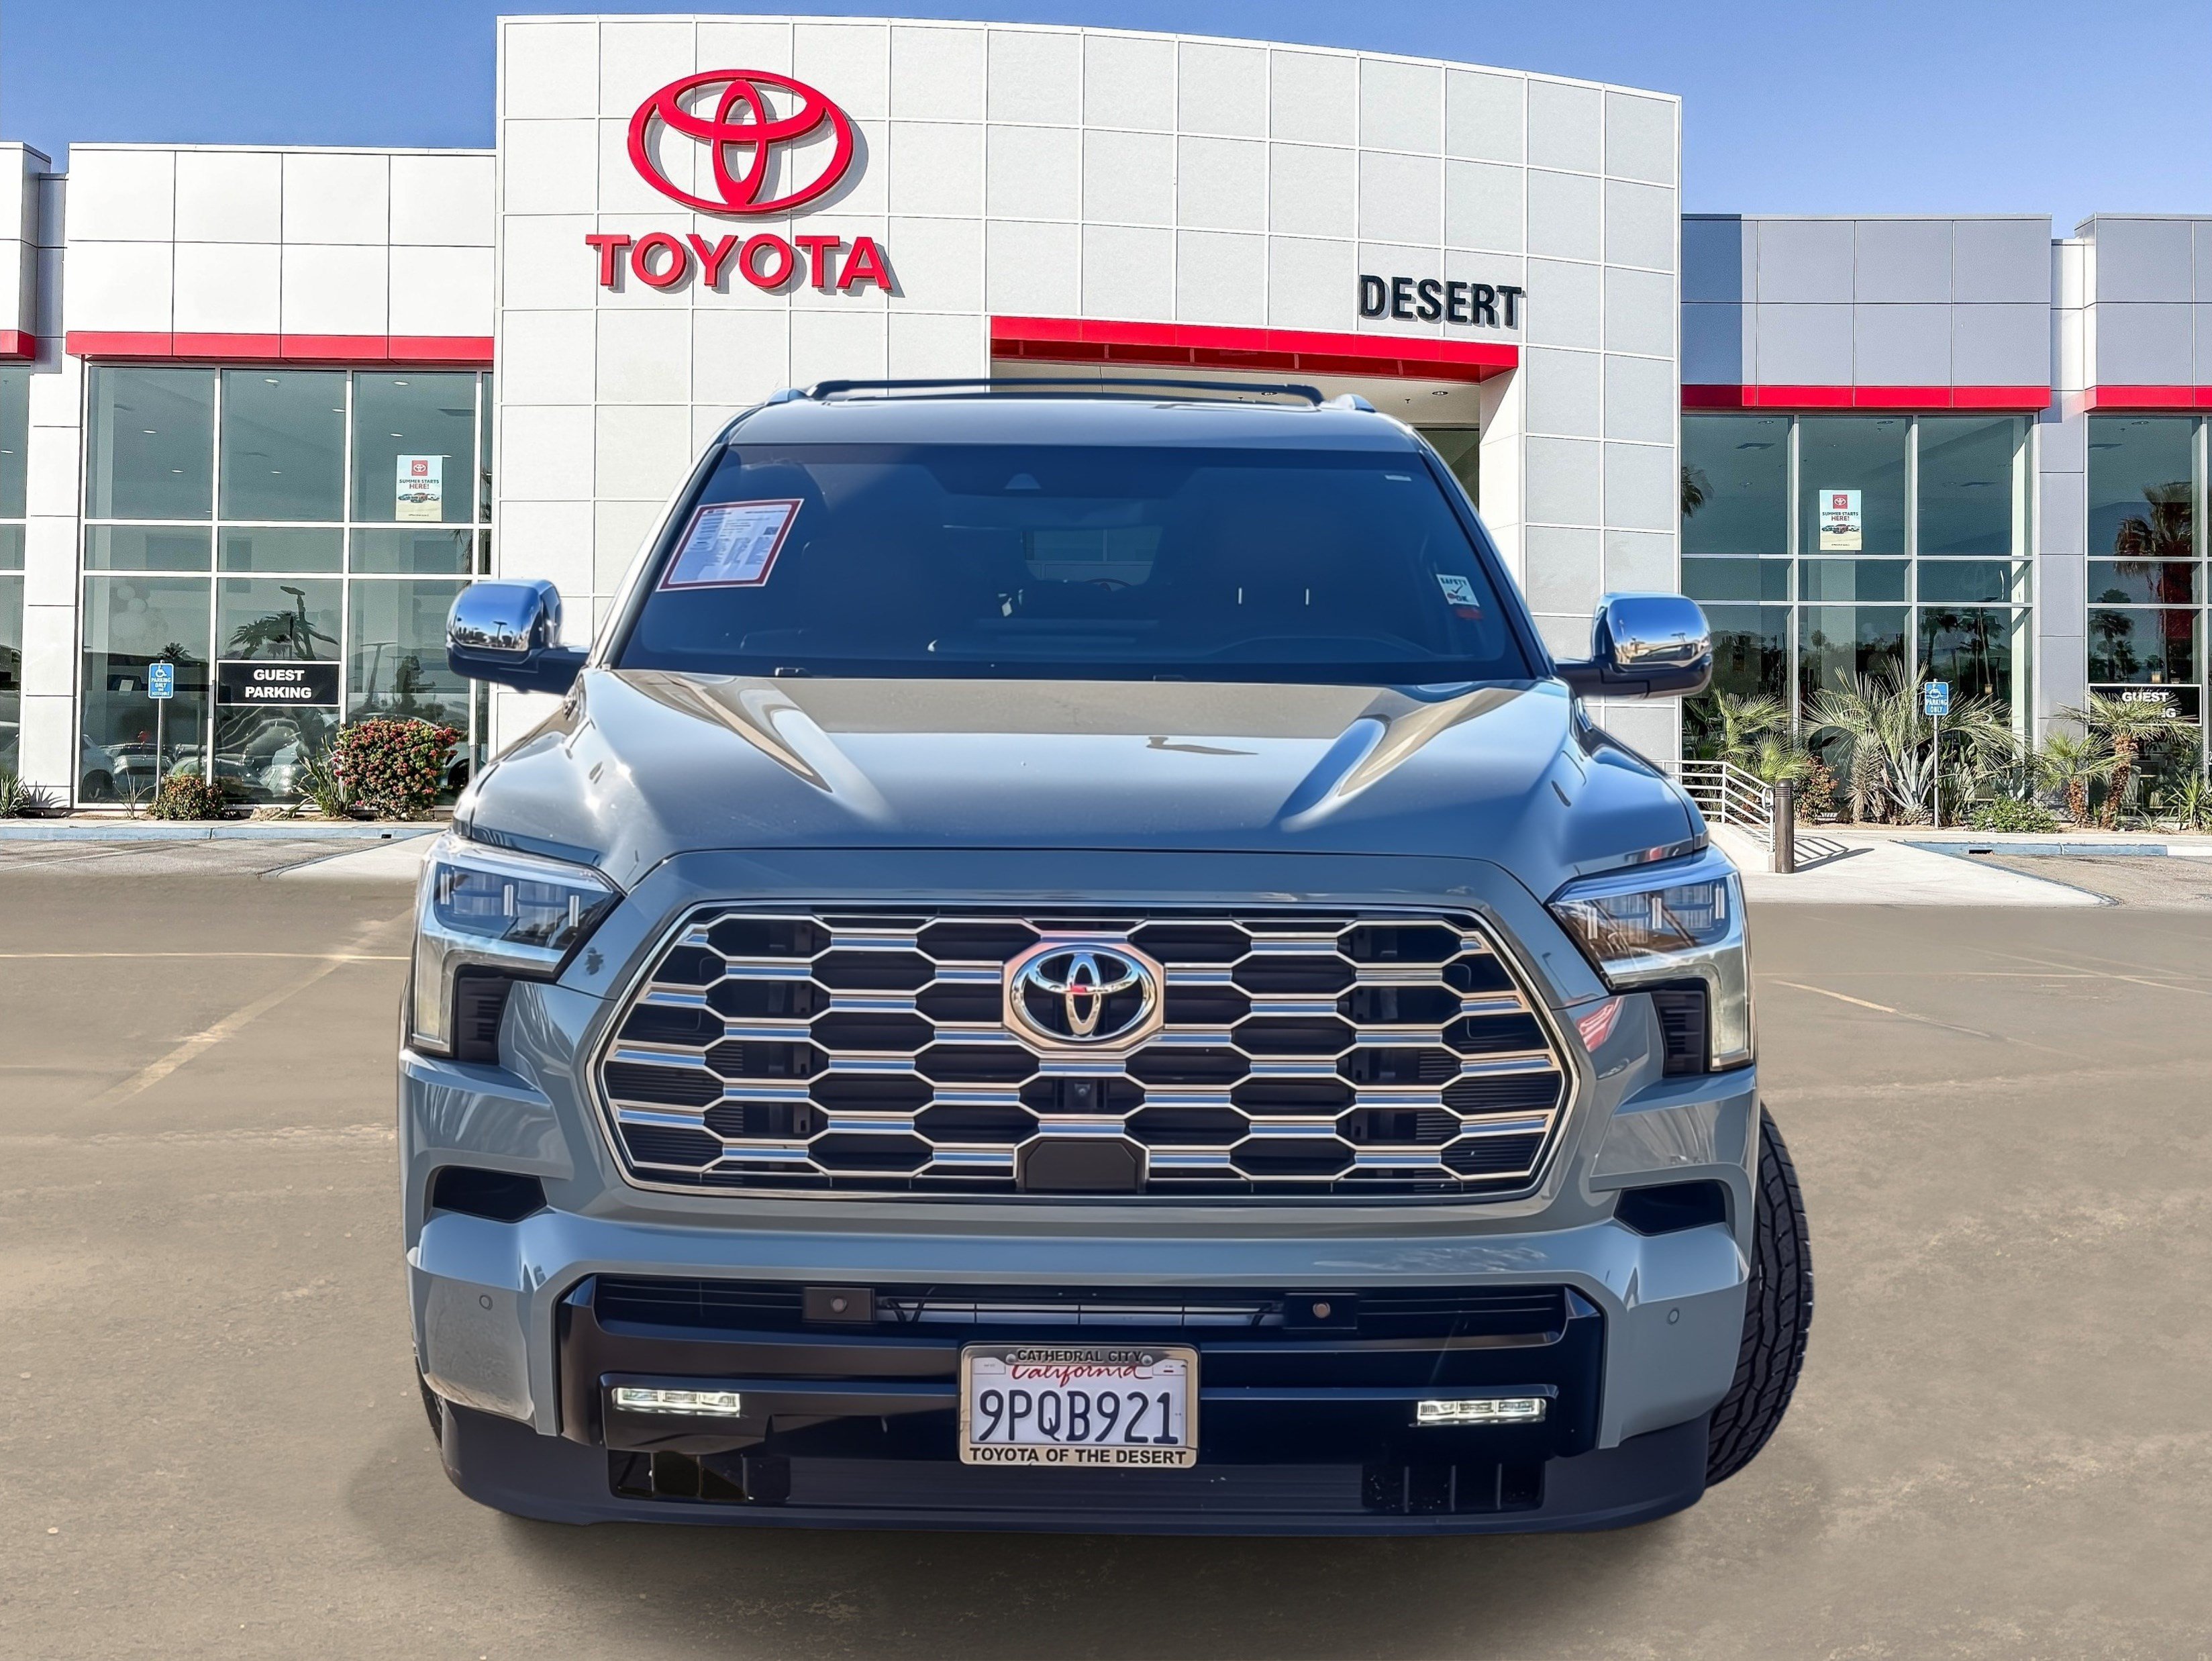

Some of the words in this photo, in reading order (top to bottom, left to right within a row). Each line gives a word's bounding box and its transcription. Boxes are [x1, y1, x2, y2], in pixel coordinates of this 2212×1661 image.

[585, 232, 891, 290] TOYOTA
[1359, 274, 1522, 326] DESERT
[253, 669, 305, 681] GUEST
[245, 686, 311, 699] PARKING
[2121, 692, 2169, 703] GUEST
[1017, 1350, 1103, 1362] CATHEDRAL
[1108, 1351, 1142, 1362] CITY
[1011, 1364, 1154, 1388] California
[978, 1389, 1178, 1444] 9PQB921
[970, 1448, 1039, 1462] TOYOTA
[1046, 1448, 1068, 1462] OF
[1074, 1449, 1111, 1463] THE
[1116, 1450, 1187, 1464] DESERT
